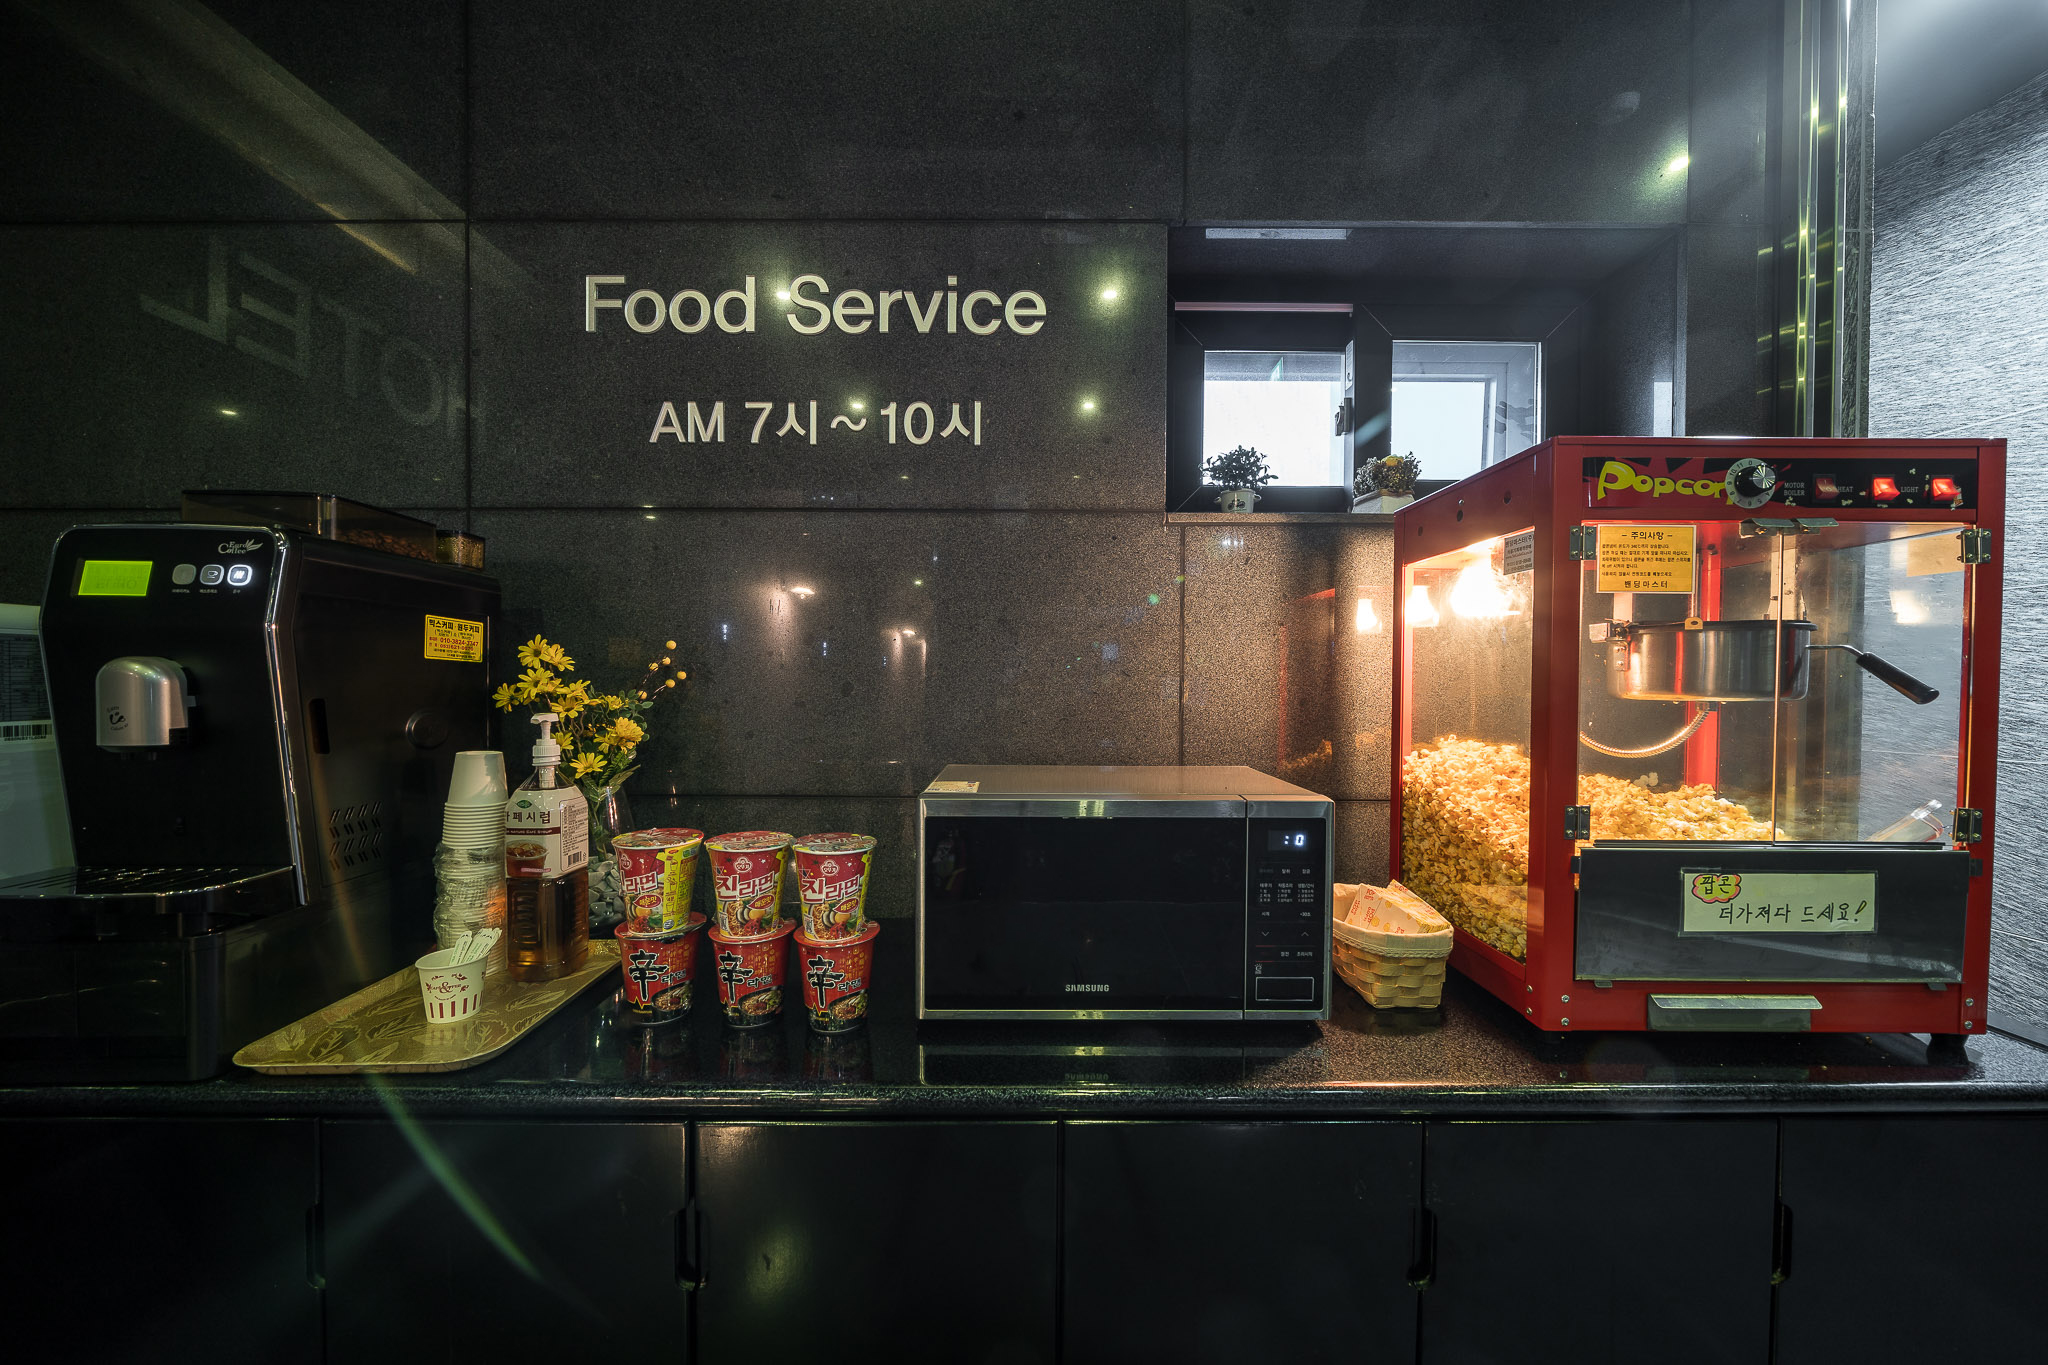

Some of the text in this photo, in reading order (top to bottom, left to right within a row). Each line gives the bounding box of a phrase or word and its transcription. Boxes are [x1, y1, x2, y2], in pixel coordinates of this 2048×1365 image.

[585, 274, 1047, 335] Food Service
[649, 401, 725, 443] AM
[715, 871, 776, 901] 진라면
[801, 874, 860, 903] 진라면
[840, 900, 857, 911] 매운맛
[1800, 900, 1868, 923] 드세요!
[628, 949, 670, 1002] 辛
[718, 950, 754, 1004] 辛
[806, 955, 845, 1009] 辛
[1065, 984, 1110, 992] SAMSUNG
